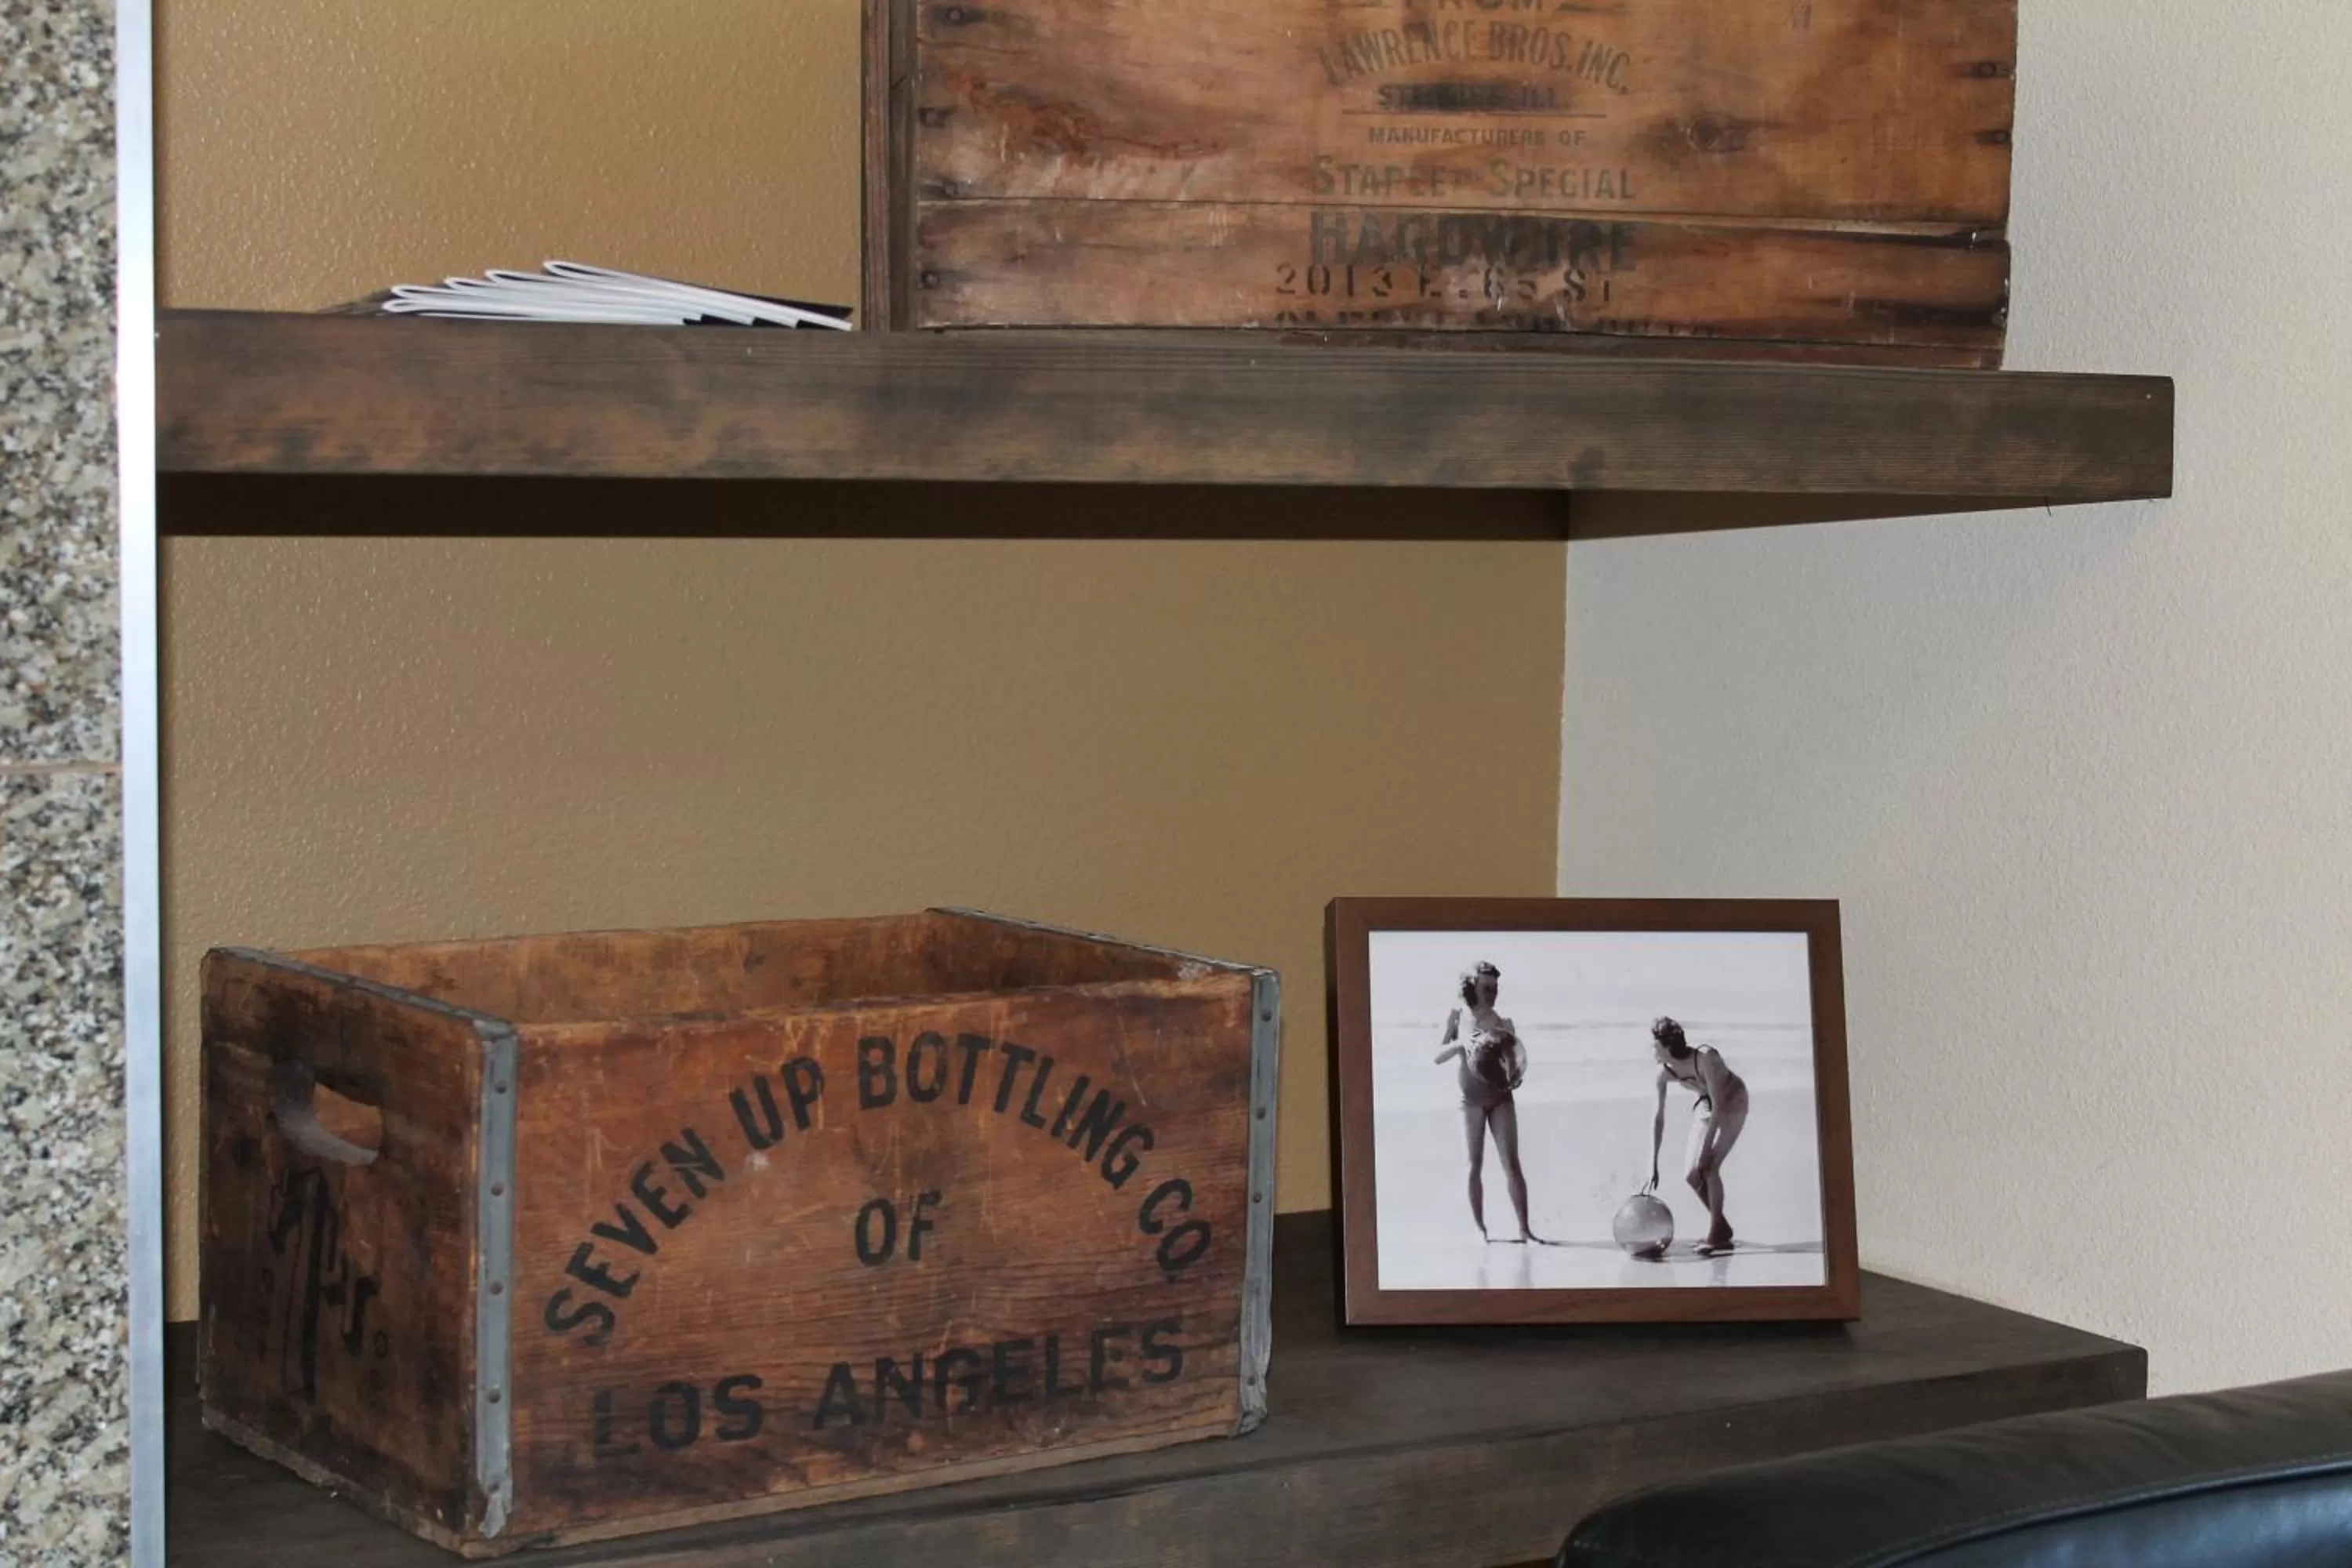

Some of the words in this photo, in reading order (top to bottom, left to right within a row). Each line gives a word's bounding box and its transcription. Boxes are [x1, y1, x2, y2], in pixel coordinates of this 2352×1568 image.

[1319, 19, 1476, 86] LAWRENCE
[1576, 39, 1632, 95] INC.
[1369, 126, 1545, 146] MANUFACTURERS
[1559, 129, 1588, 146] OF
[1490, 157, 1636, 201] SPECIAL
[1276, 263, 1392, 298] 2013
[544, 1127, 726, 1347] SEVEN
[728, 1056, 825, 1150] UP
[858, 1031, 1155, 1190] BOTTLING
[1138, 1178, 1211, 1283] CO
[855, 1189, 943, 1267] OF
[593, 1374, 765, 1458] LOS
[813, 1317, 1185, 1431] ANGELES
